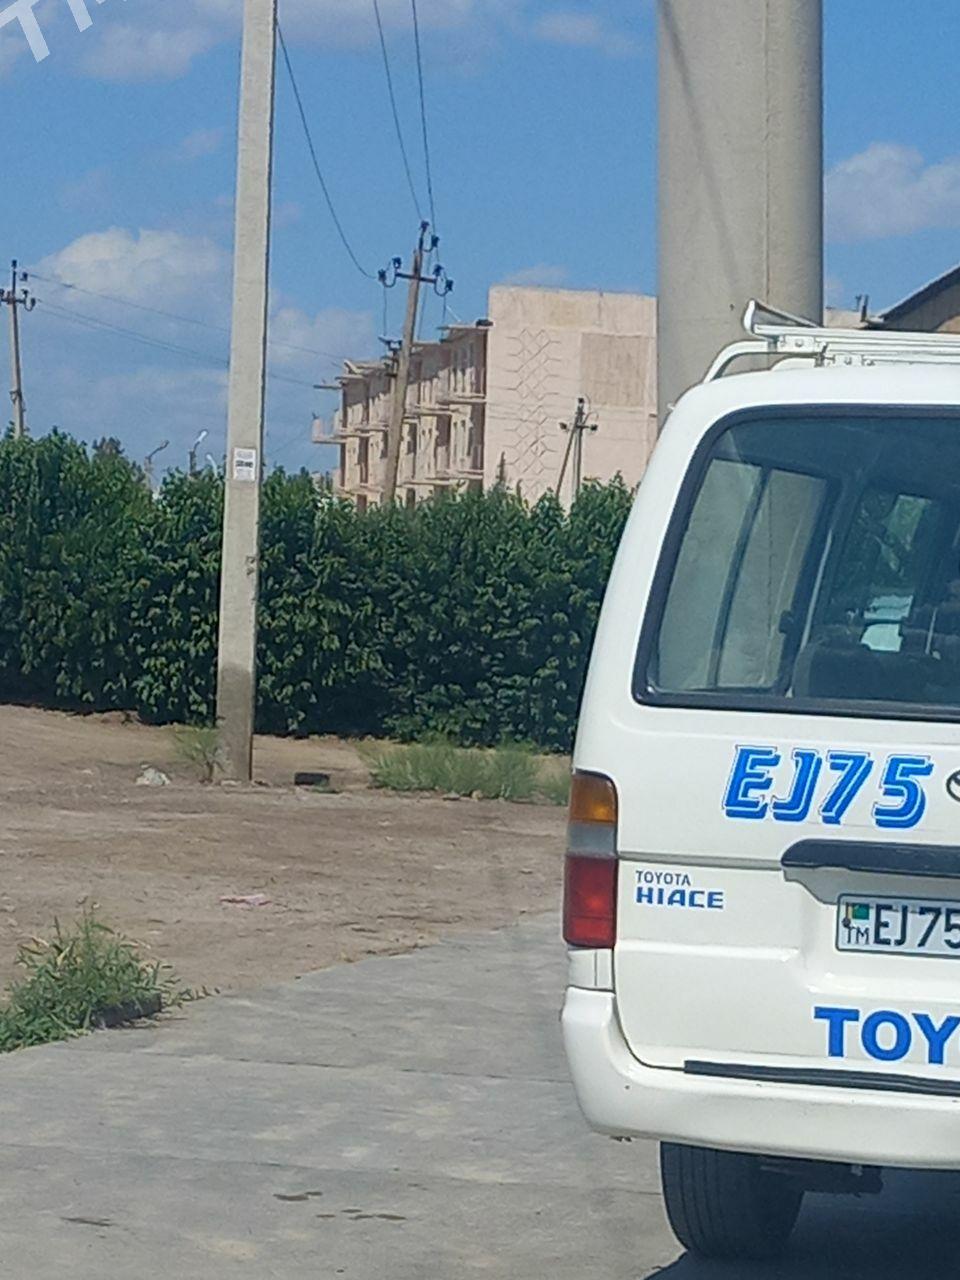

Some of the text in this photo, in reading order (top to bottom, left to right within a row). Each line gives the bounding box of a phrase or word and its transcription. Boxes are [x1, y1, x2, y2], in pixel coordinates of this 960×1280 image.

[722, 745, 935, 829] EJ75
[635, 870, 691, 886] TOYOTA
[636, 887, 724, 909] HIACE
